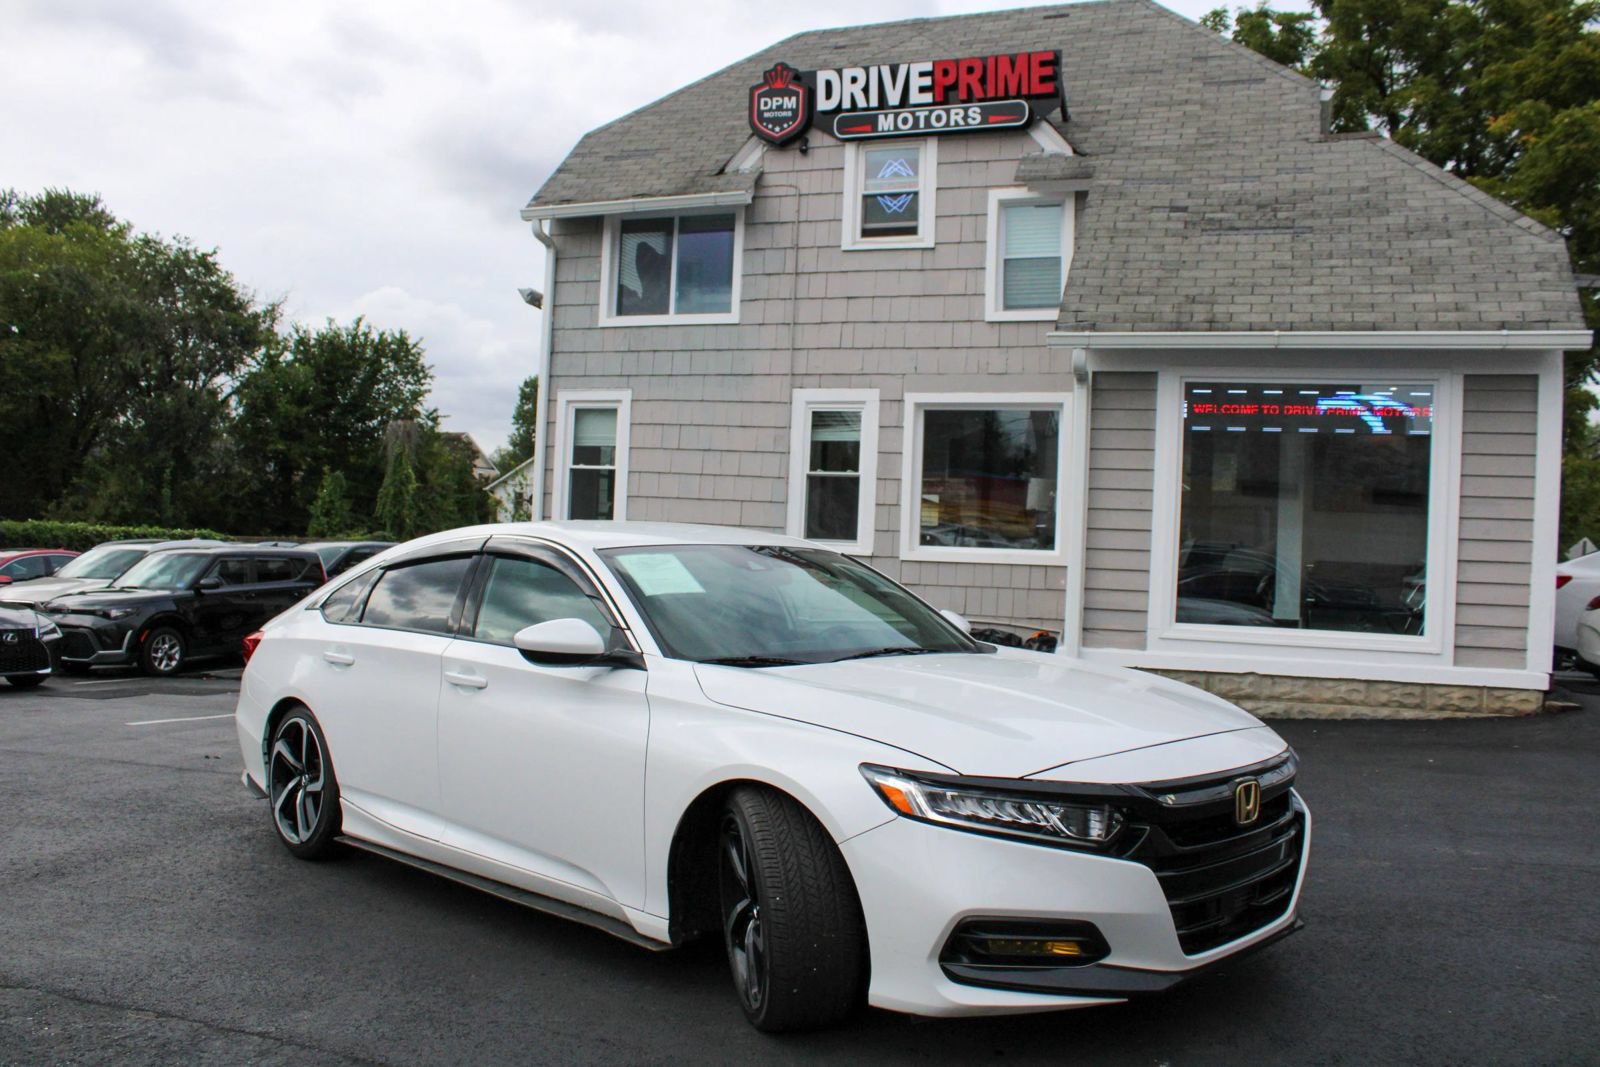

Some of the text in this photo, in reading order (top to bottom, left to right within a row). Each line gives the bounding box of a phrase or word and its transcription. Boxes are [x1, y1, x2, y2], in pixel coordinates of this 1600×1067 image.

[760, 96, 797, 110] DPM
[877, 107, 982, 132] MOTORS
[1193, 404, 1259, 414] WELCOME
[1262, 405, 1280, 415] TO
